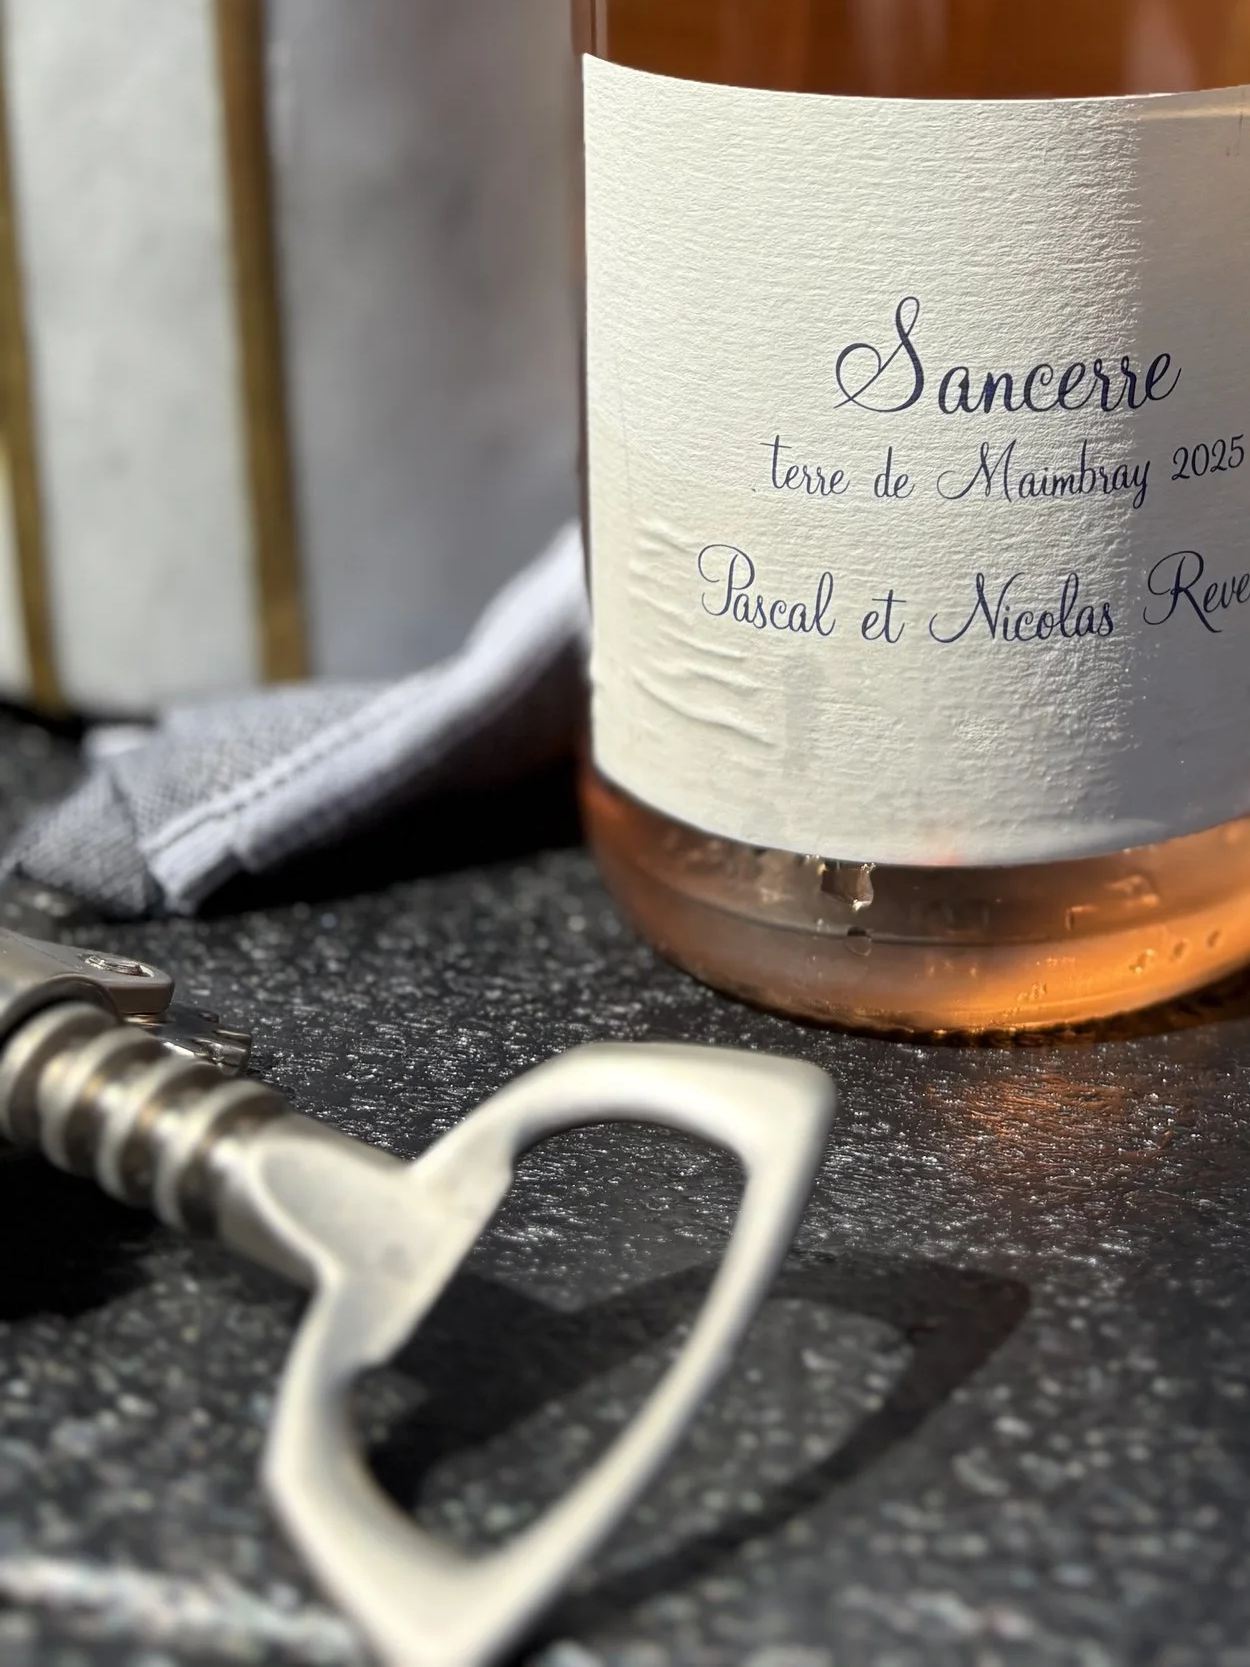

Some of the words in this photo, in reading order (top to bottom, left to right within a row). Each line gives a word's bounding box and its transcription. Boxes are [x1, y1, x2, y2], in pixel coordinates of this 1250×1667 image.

[834, 295, 1182, 414] Sancerre
[760, 433, 850, 494] terre
[872, 445, 915, 500] de
[936, 439, 1152, 509] Maimbray
[1170, 433, 1246, 482] 2025
[696, 542, 836, 637] Pascal
[861, 587, 906, 644] et
[928, 570, 1115, 645] Nicolas
